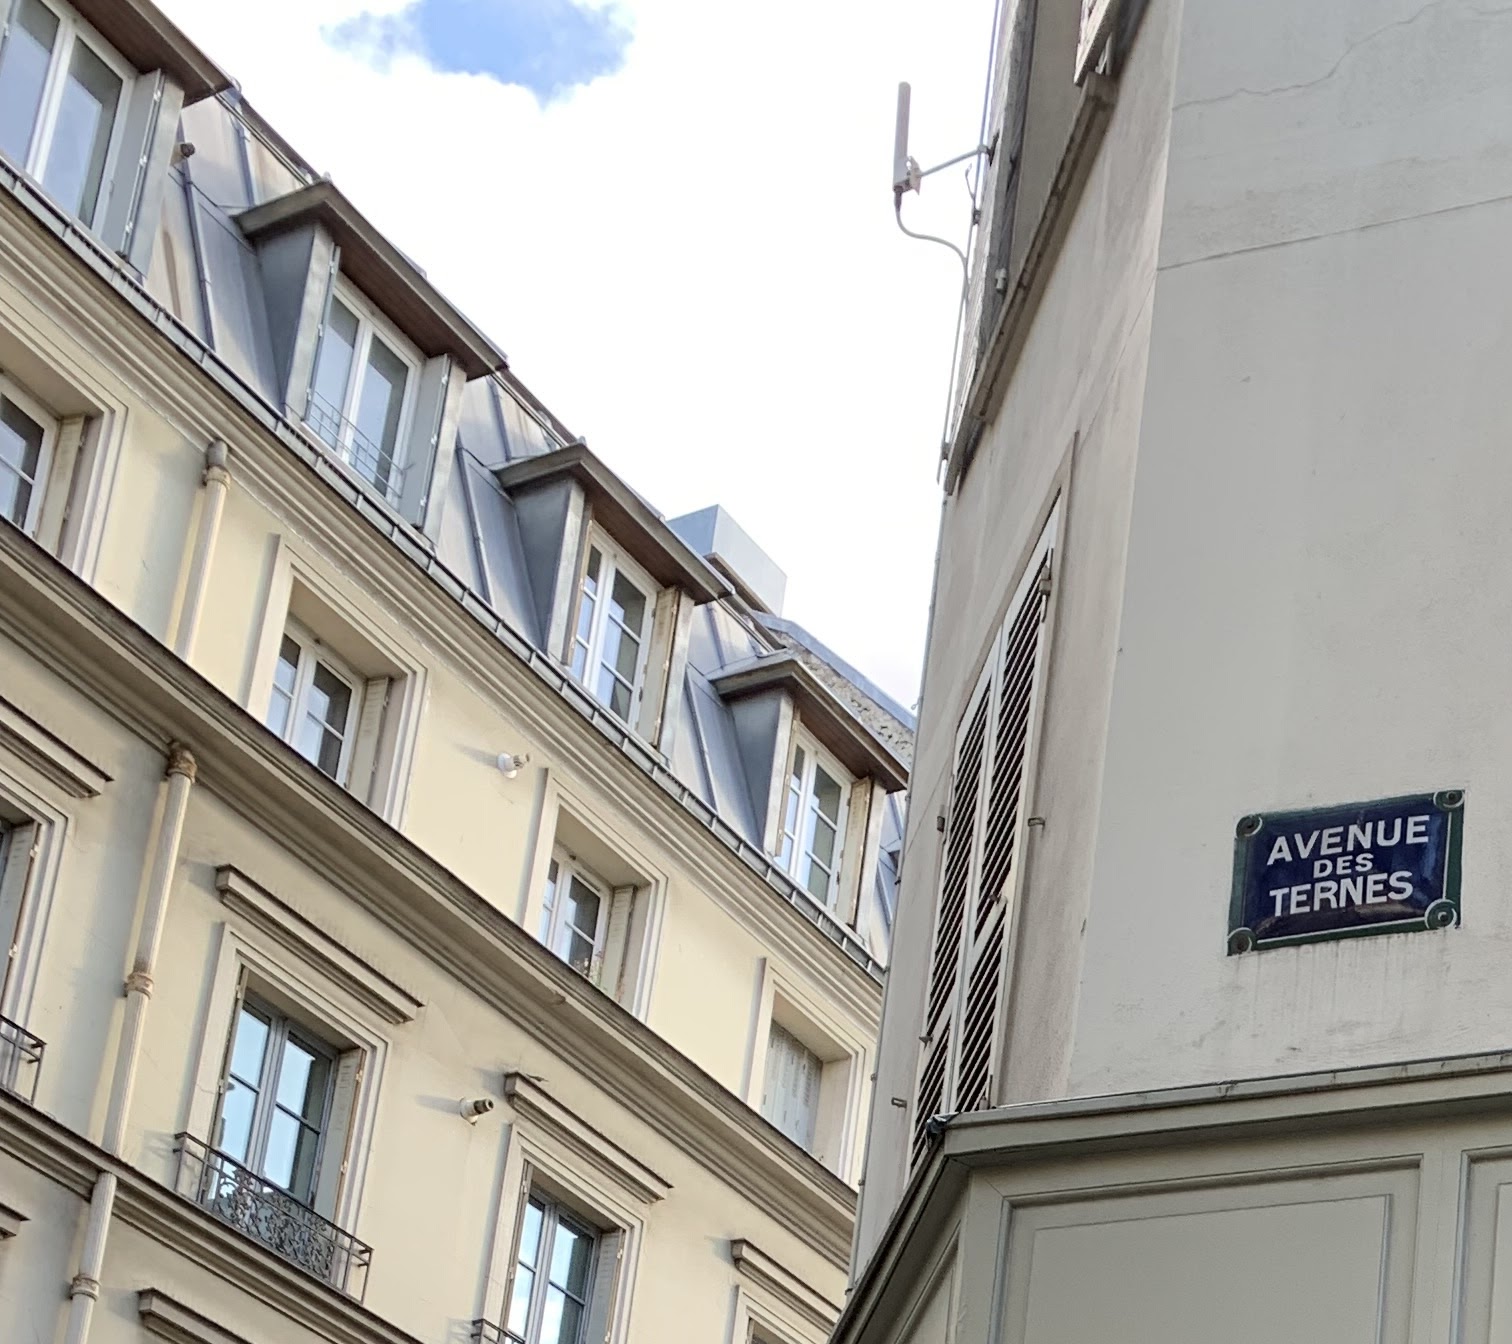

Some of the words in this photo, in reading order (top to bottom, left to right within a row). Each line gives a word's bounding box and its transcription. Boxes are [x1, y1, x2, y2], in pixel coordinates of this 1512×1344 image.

[1266, 815, 1430, 865] AVENUE
[1313, 852, 1374, 879] DES
[1269, 871, 1414, 917] TERNES
